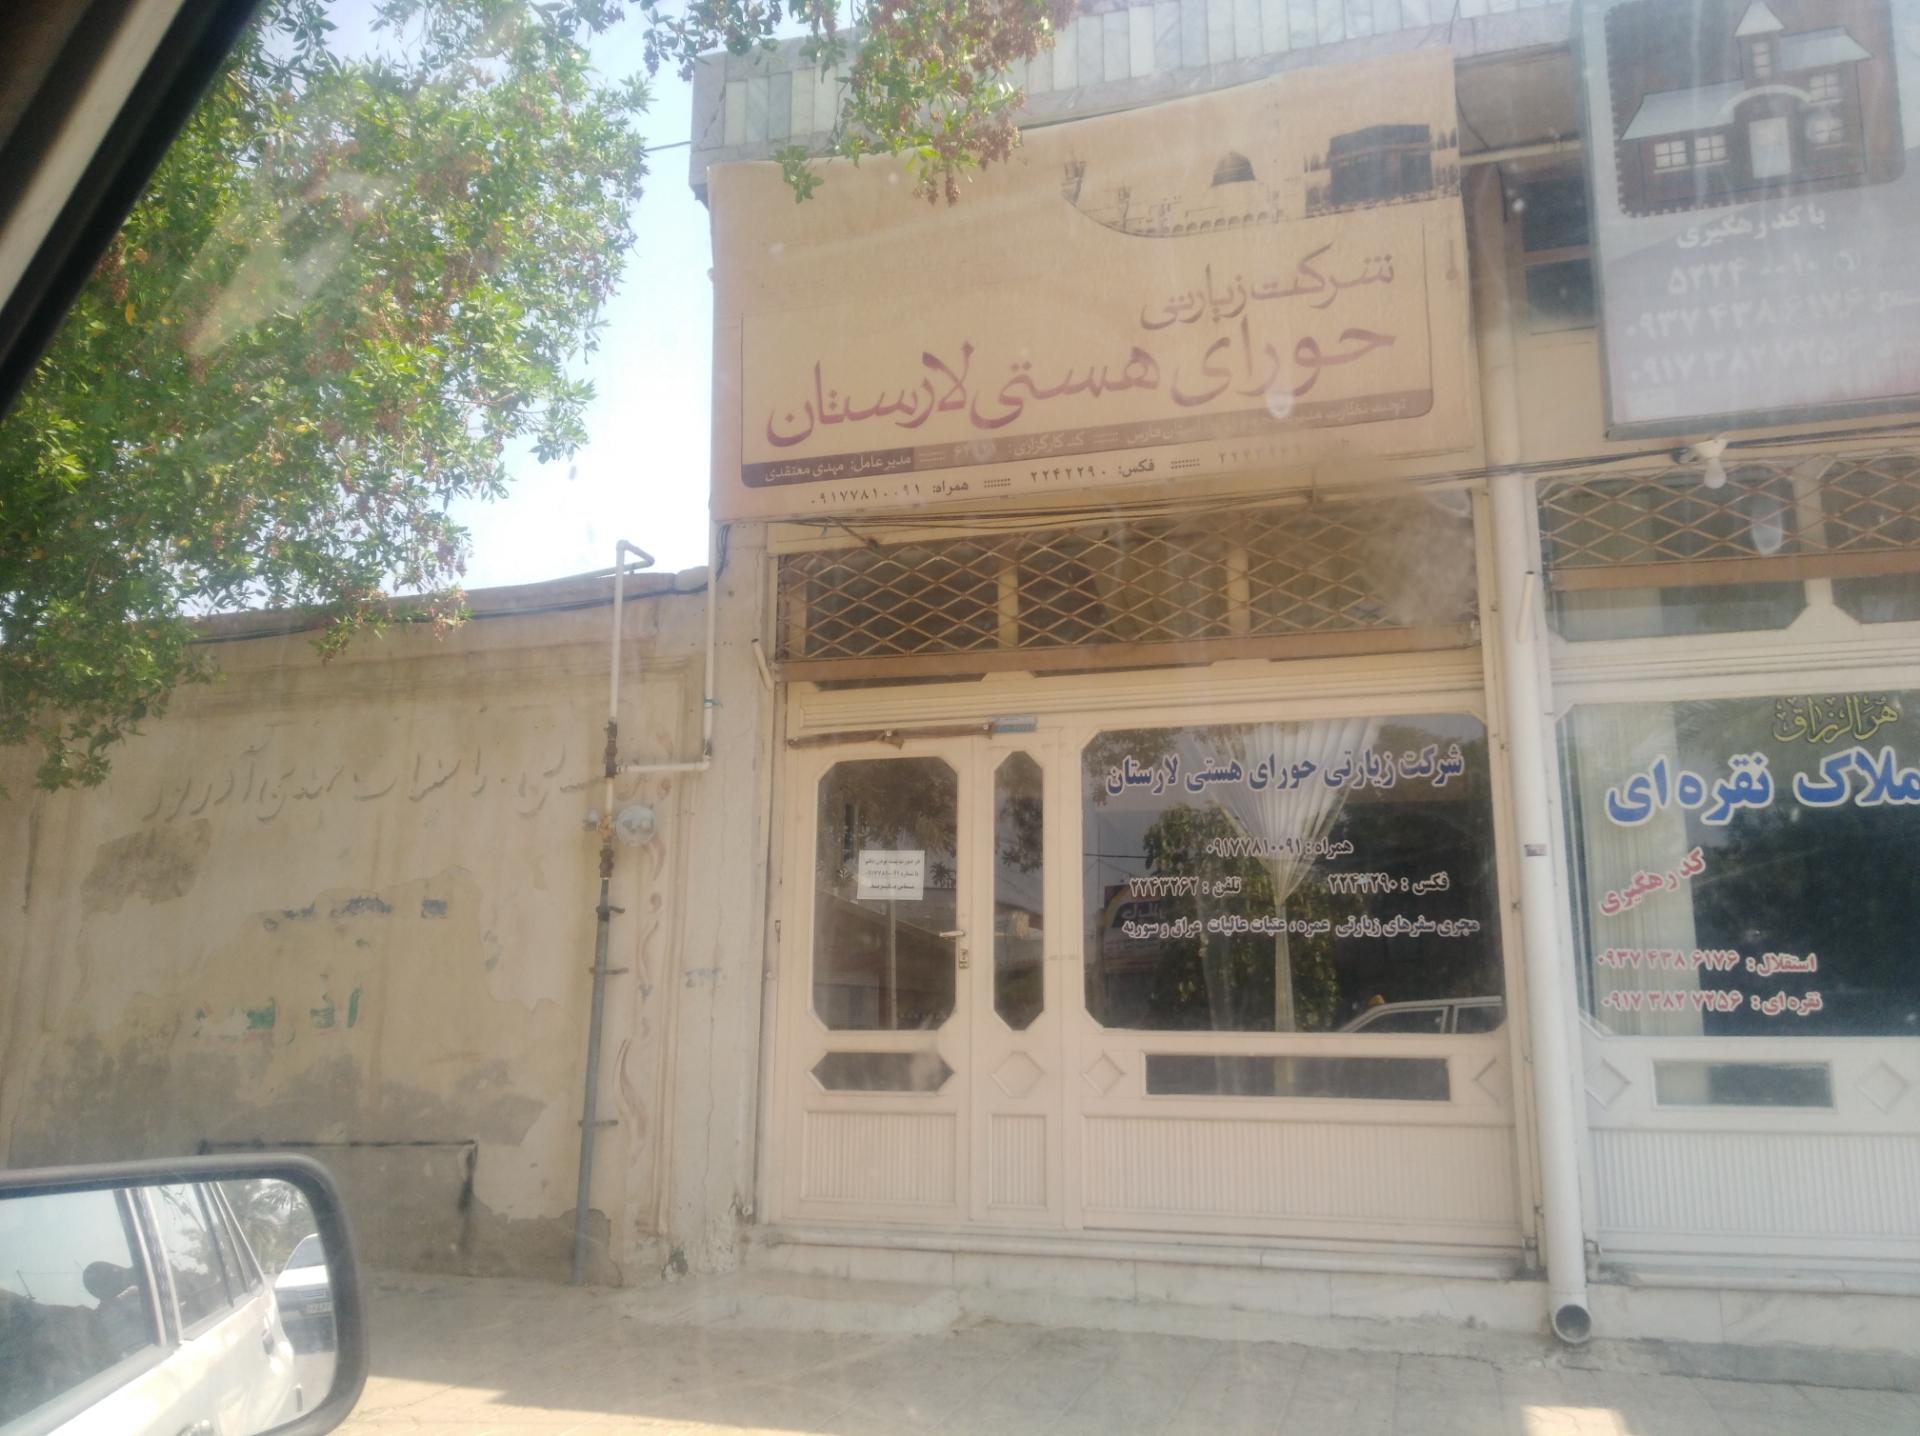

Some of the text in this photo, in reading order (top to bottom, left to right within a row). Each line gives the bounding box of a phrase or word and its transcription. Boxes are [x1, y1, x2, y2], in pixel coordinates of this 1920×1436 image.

[1771, 204, 1802, 229] کد
[1808, 203, 1826, 229] با
[1140, 240, 1395, 330] شرکت زیارتی
[765, 315, 1396, 448] حورای هستی لارستان
[812, 463, 845, 478] مهدی
[884, 454, 912, 470] مدیر
[810, 483, 920, 504] ۰۹۱۷۷۸۱۰۰۹۱
[1106, 744, 1464, 795] شرکت زیارتی حورای هستی لارستان
[1206, 836, 1301, 857] ۰۹۱۷۷۸۱۰۰۹۱
[1680, 847, 1706, 879] کد
[1129, 876, 1199, 897] ۲۲۴۳۲۶۲
[1122, 920, 1159, 938] سوریه
[1159, 923, 1170, 938] و
[1170, 916, 1203, 938] عراق
[1207, 915, 1249, 937] عالیات
[1250, 915, 1288, 937] عتبات
[1335, 914, 1381, 937] زیارتی
[1437, 918, 1480, 937] مجری
[1597, 948, 1642, 969] ۰۹۳۷
[1646, 949, 1687, 970] ۴۳۸
[1691, 949, 1740, 971] ۶۱۷۶
[1602, 990, 1642, 1011] ۰۹۱۷
[1648, 990, 1686, 1010] ۳۸۲
[1690, 990, 1743, 1011] ۷۲۵۶
